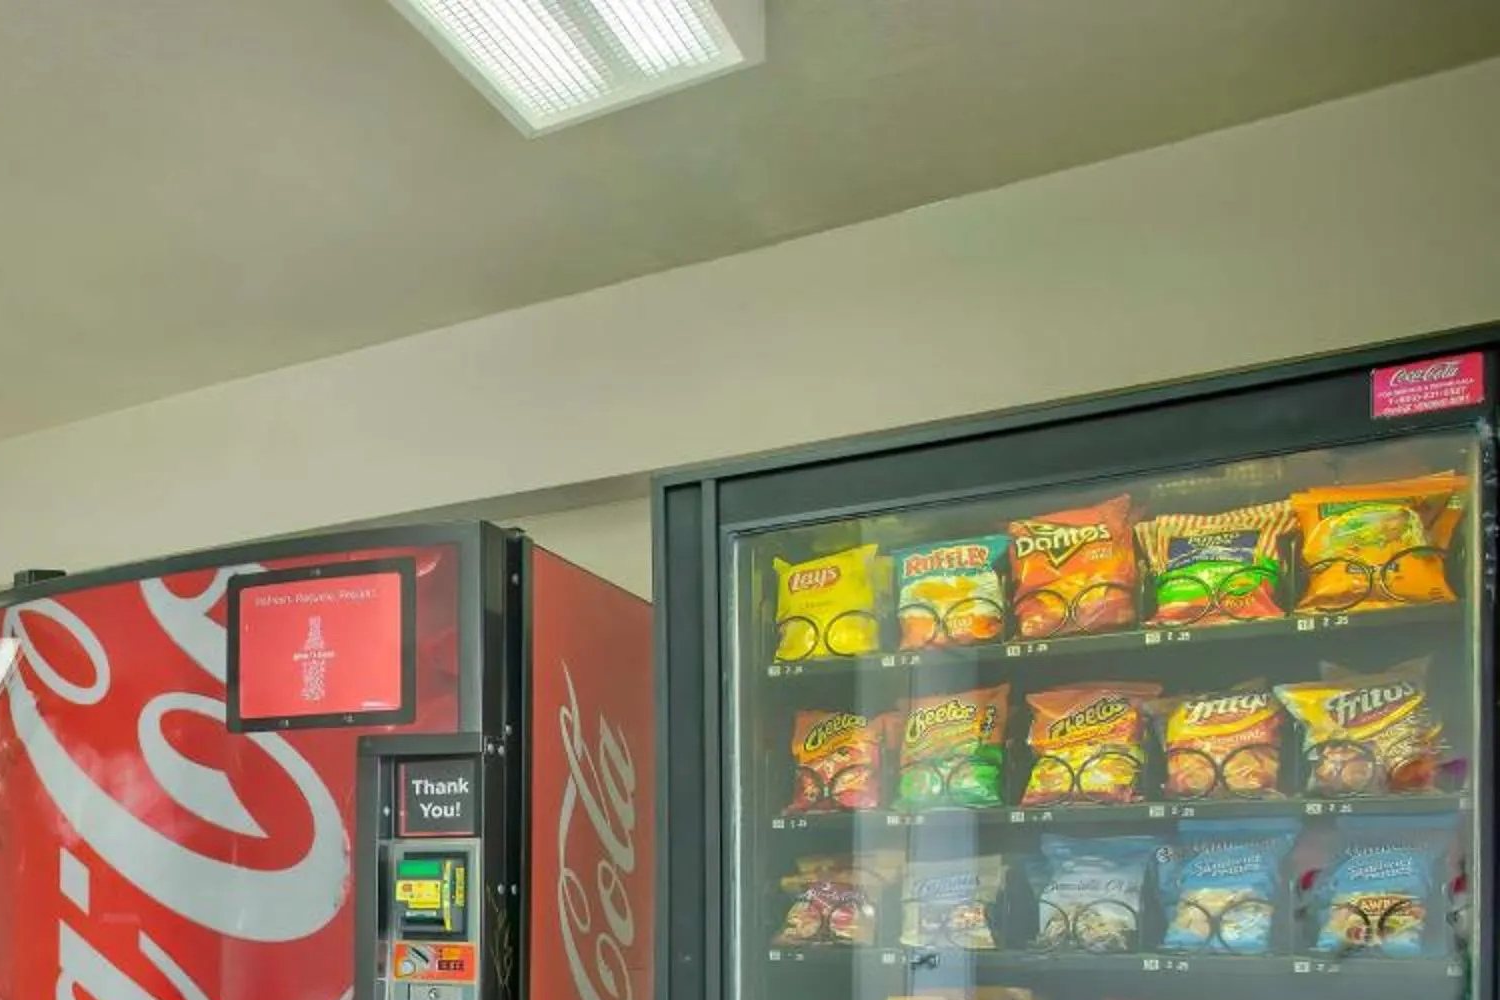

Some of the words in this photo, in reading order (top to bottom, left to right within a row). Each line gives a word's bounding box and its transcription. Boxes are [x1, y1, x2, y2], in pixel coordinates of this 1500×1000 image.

[1389, 360, 1460, 387] Coca-Cola
[411, 777, 470, 796] Thank
[419, 801, 462, 818] You!
